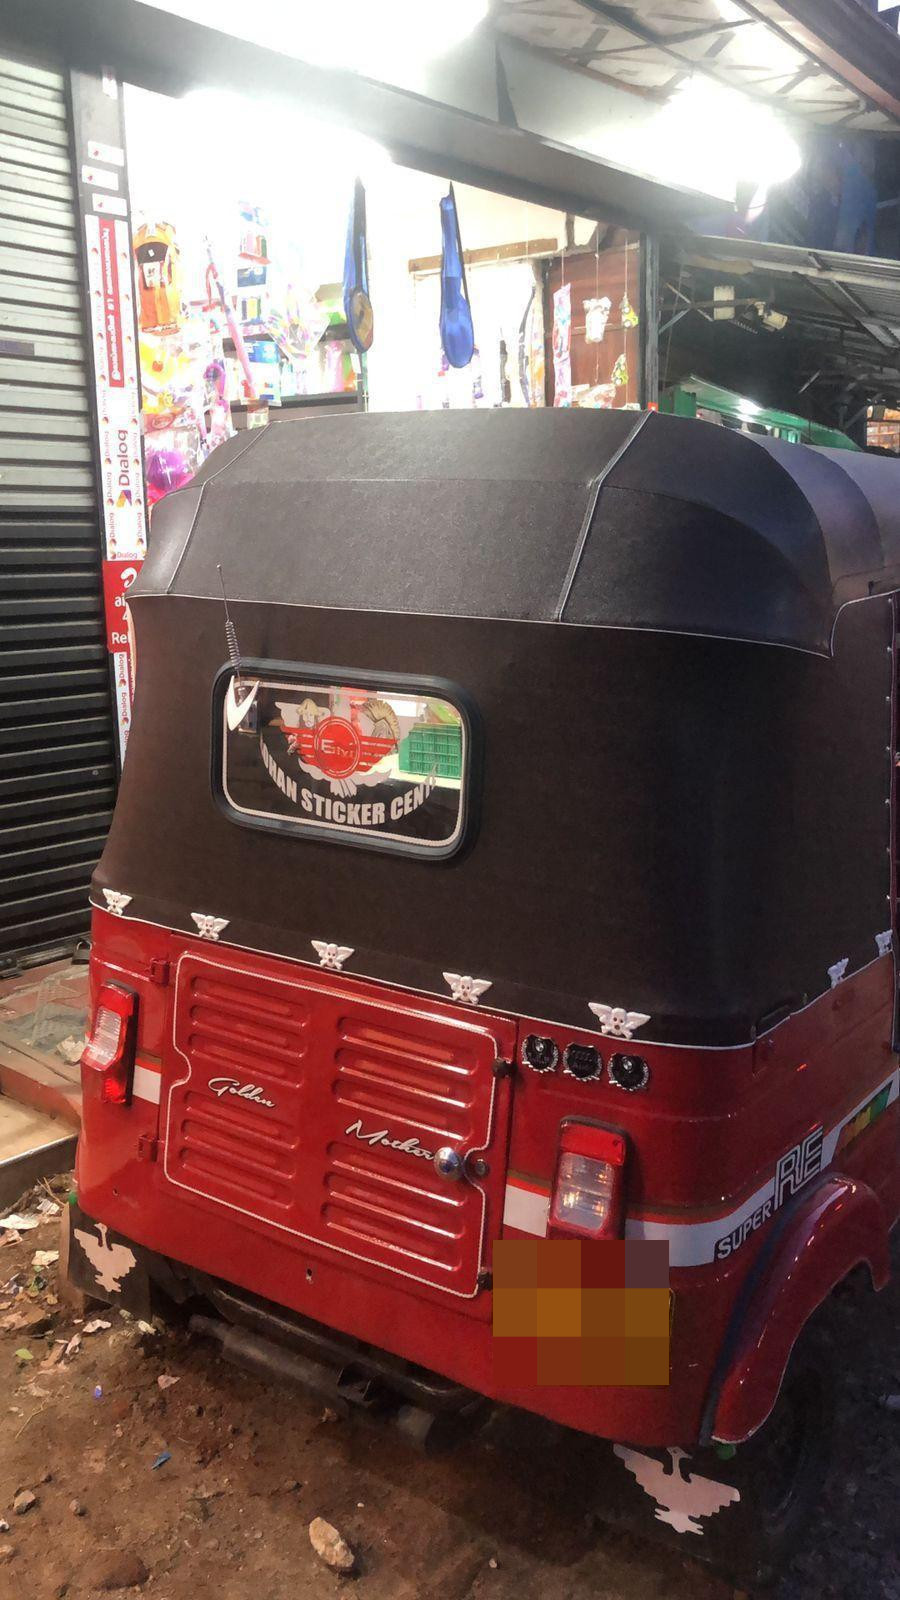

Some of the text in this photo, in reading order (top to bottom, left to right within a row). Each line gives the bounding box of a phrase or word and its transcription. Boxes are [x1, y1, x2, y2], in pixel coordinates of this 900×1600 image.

[118, 429, 130, 486] Dialog
[117, 551, 138, 560] Dialog
[301, 788, 386, 826] STICKER
[208, 1077, 435, 1161] Golden Mother
[717, 1125, 824, 1260] SUPER RE
